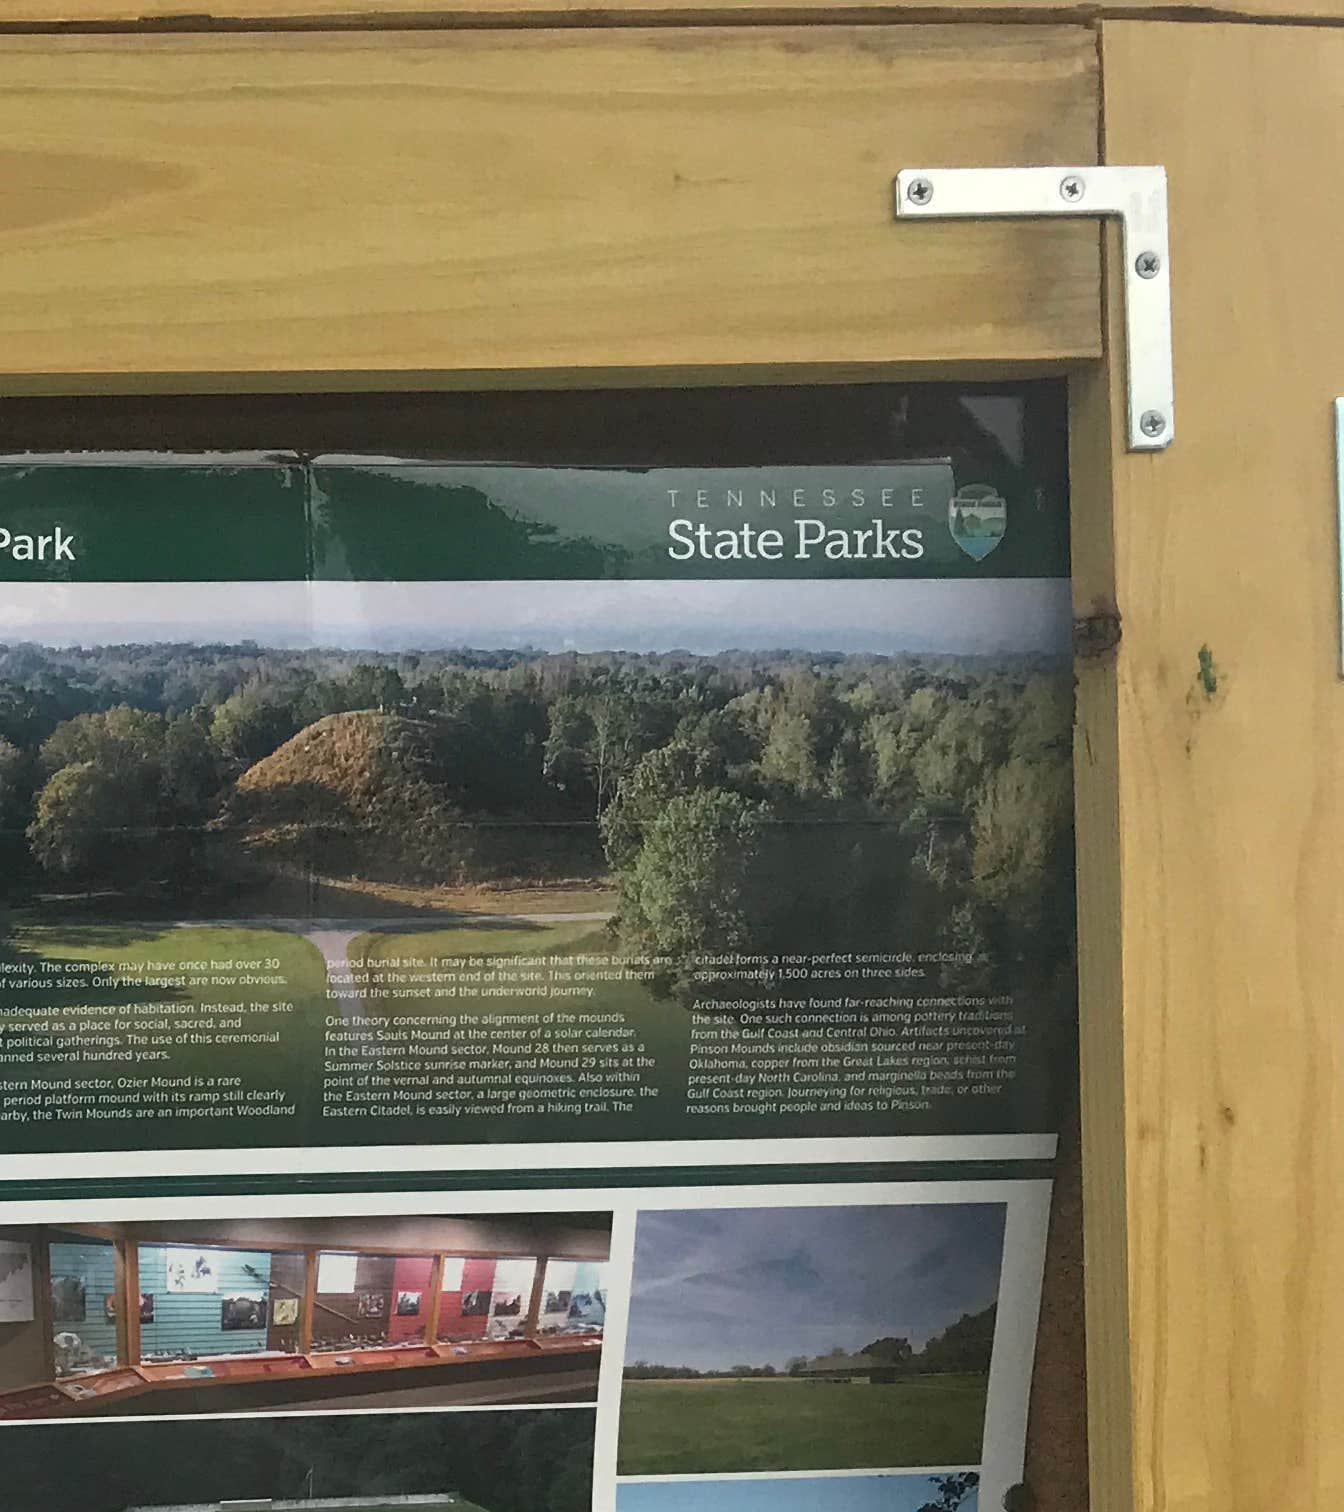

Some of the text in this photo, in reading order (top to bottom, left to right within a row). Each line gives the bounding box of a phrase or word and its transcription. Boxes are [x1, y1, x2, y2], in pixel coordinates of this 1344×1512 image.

[667, 488, 924, 508] TENNESSEE
[668, 518, 924, 560] State Parks
